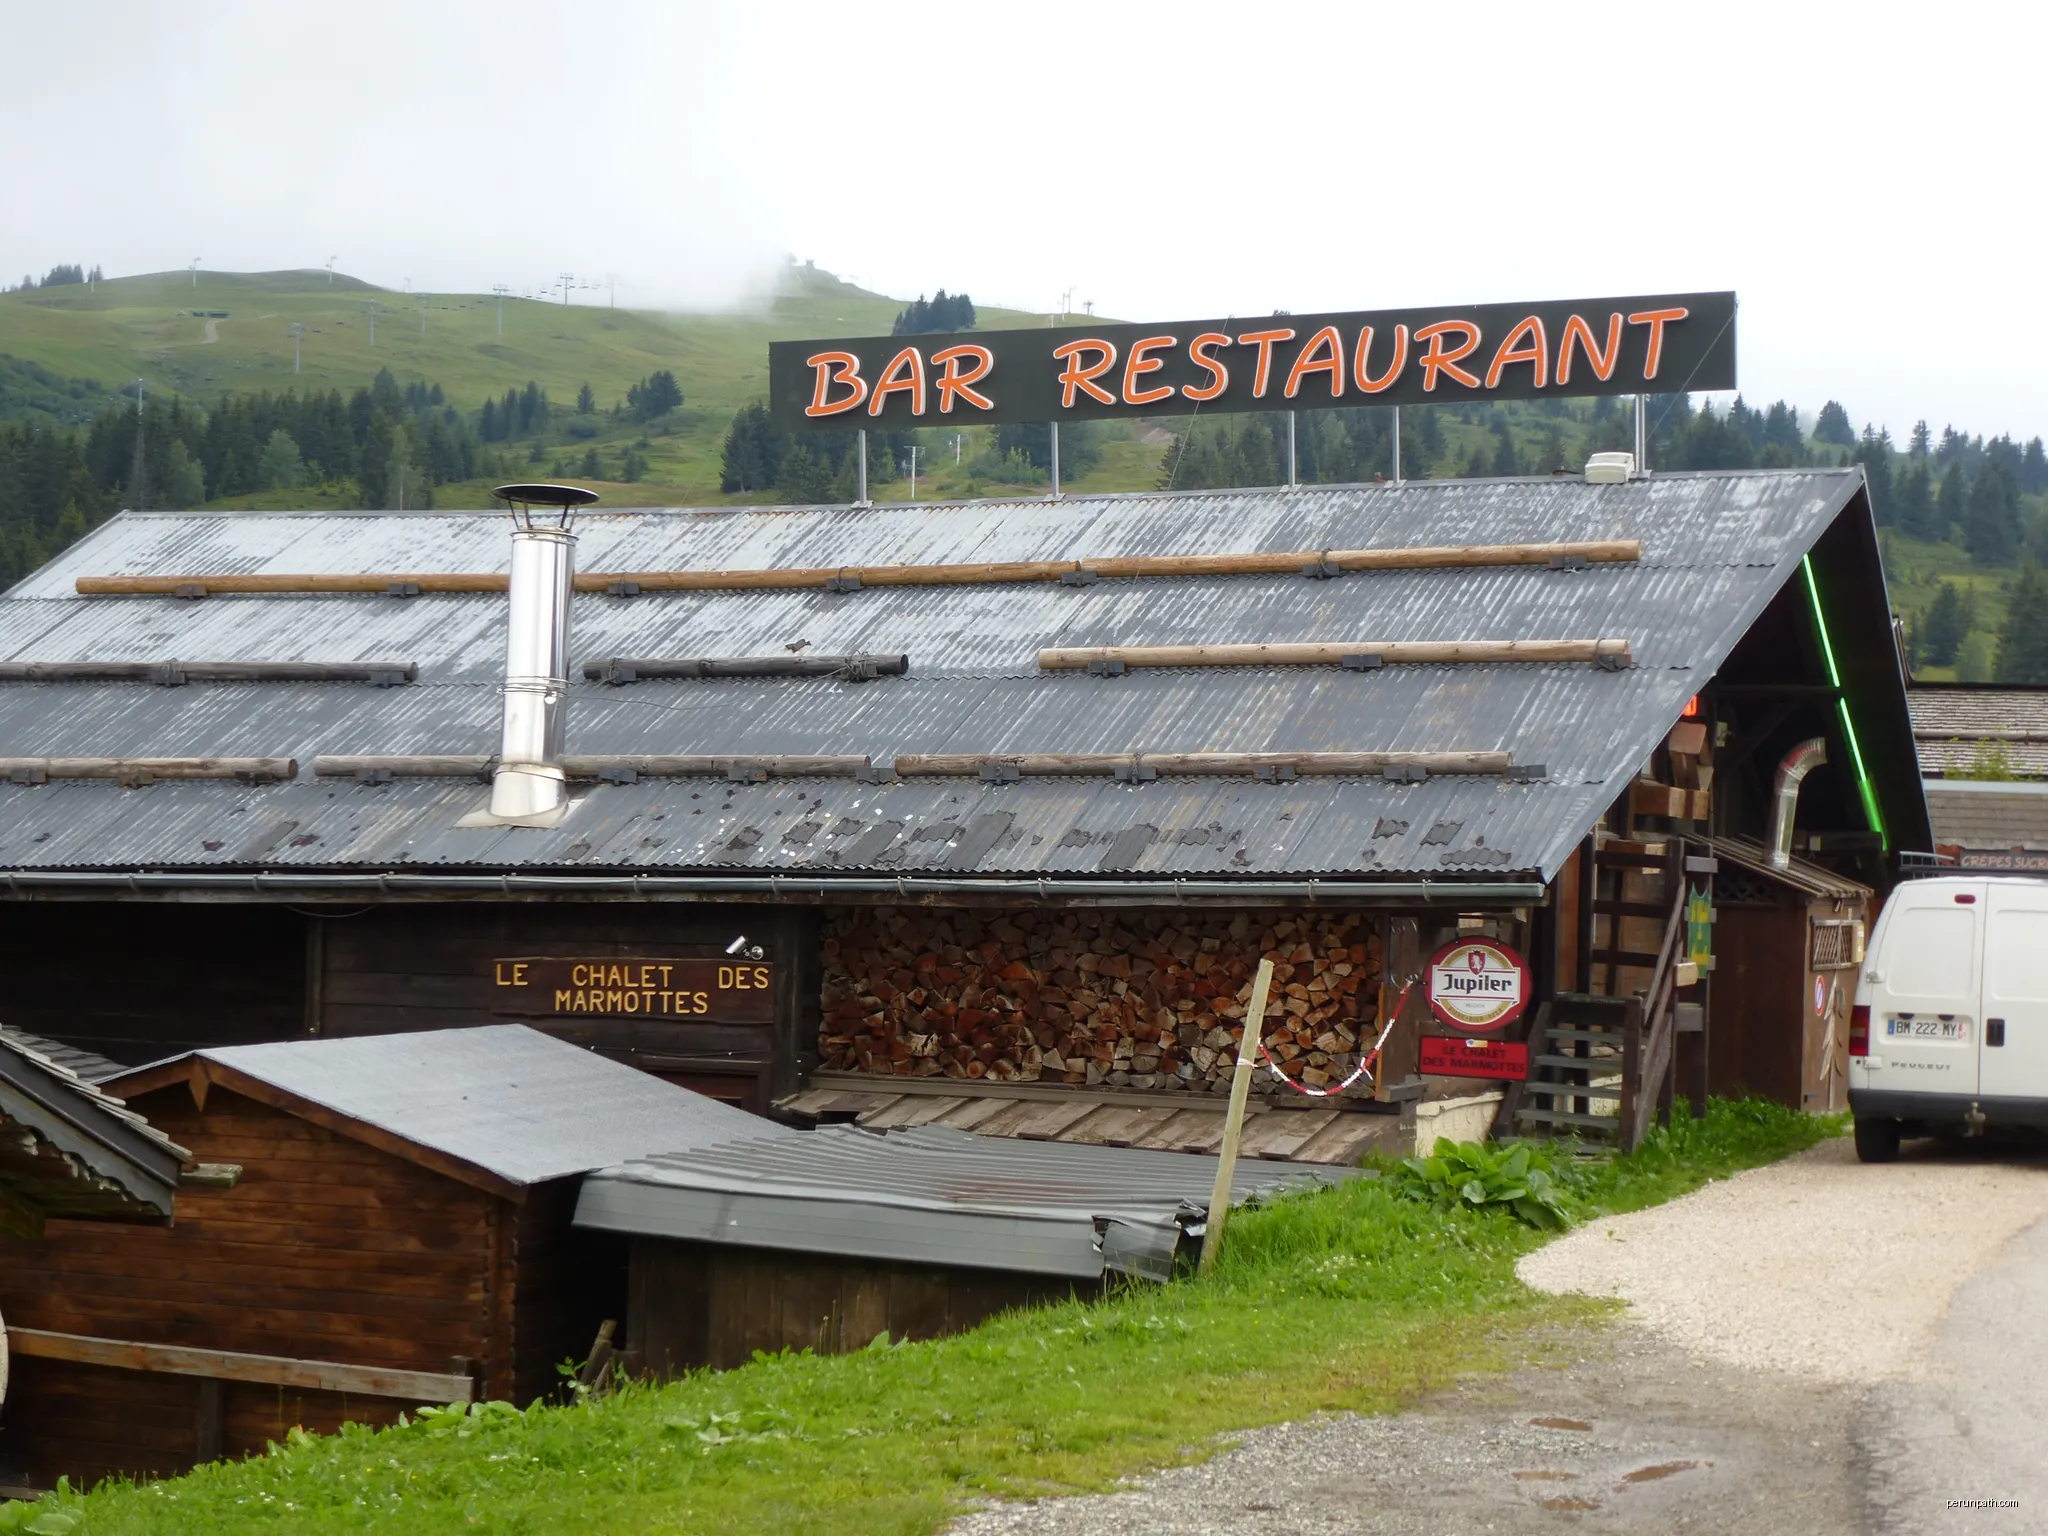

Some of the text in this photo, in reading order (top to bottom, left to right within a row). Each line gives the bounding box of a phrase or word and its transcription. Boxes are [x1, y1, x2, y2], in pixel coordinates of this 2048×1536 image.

[804, 307, 1691, 418] BAR RESTAURANT
[2015, 855, 2048, 868] SUCR
[495, 964, 770, 990] LE CHALET DES
[1442, 974, 1512, 994] Jupiler
[554, 989, 709, 1014] MARMOTTES
[1443, 1046, 1506, 1059] LE CHALET
[1423, 1057, 1525, 1073] DES MARMOTTES
